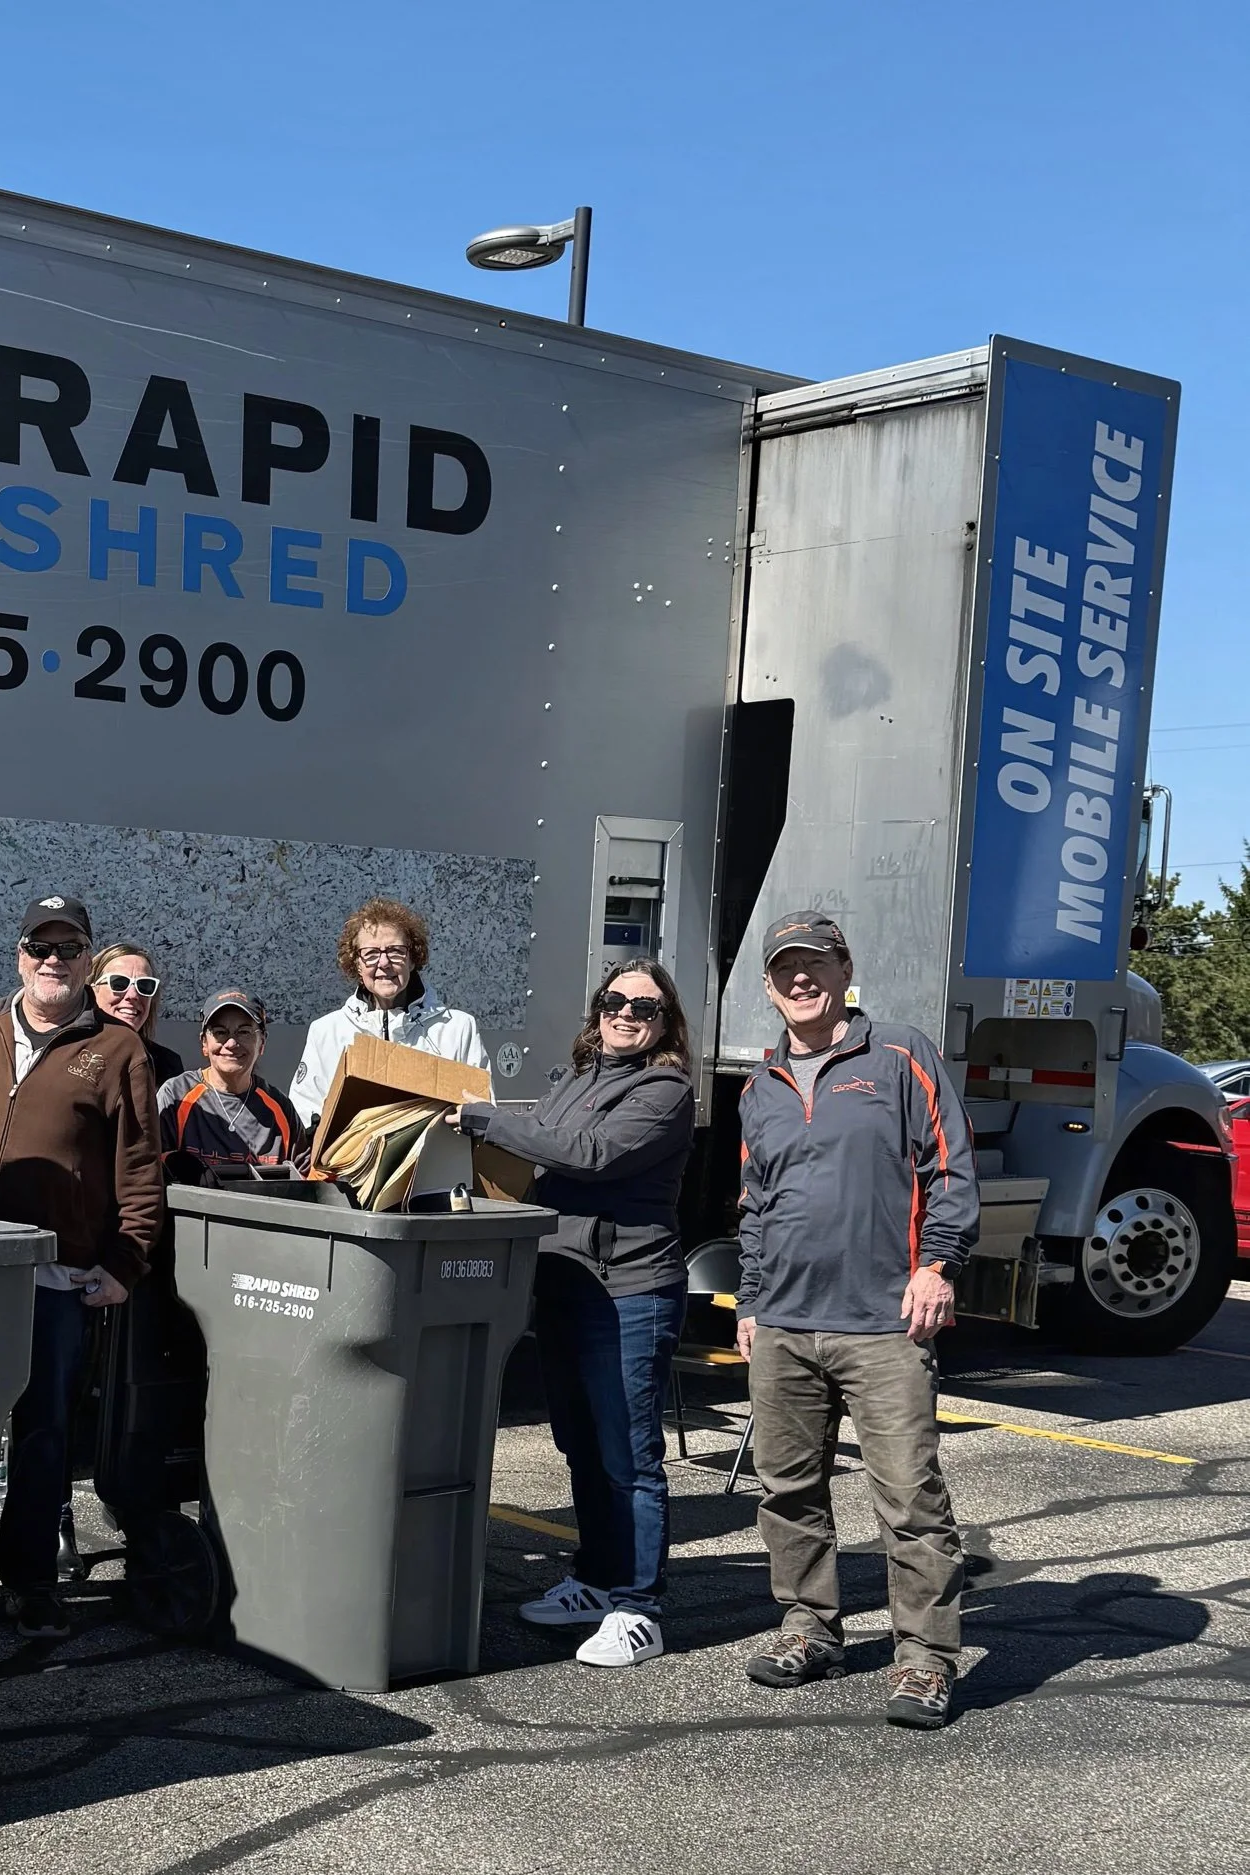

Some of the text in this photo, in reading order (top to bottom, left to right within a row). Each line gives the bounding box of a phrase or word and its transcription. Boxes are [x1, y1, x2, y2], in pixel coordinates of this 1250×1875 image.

[996, 535, 1070, 814] ON SITE
[1056, 419, 1145, 945] MOBILE SERVICE
[502, 1047, 519, 1059] AAA
[233, 1273, 320, 1301] RAPID SHRED
[233, 1292, 315, 1321] 616-735-2900
